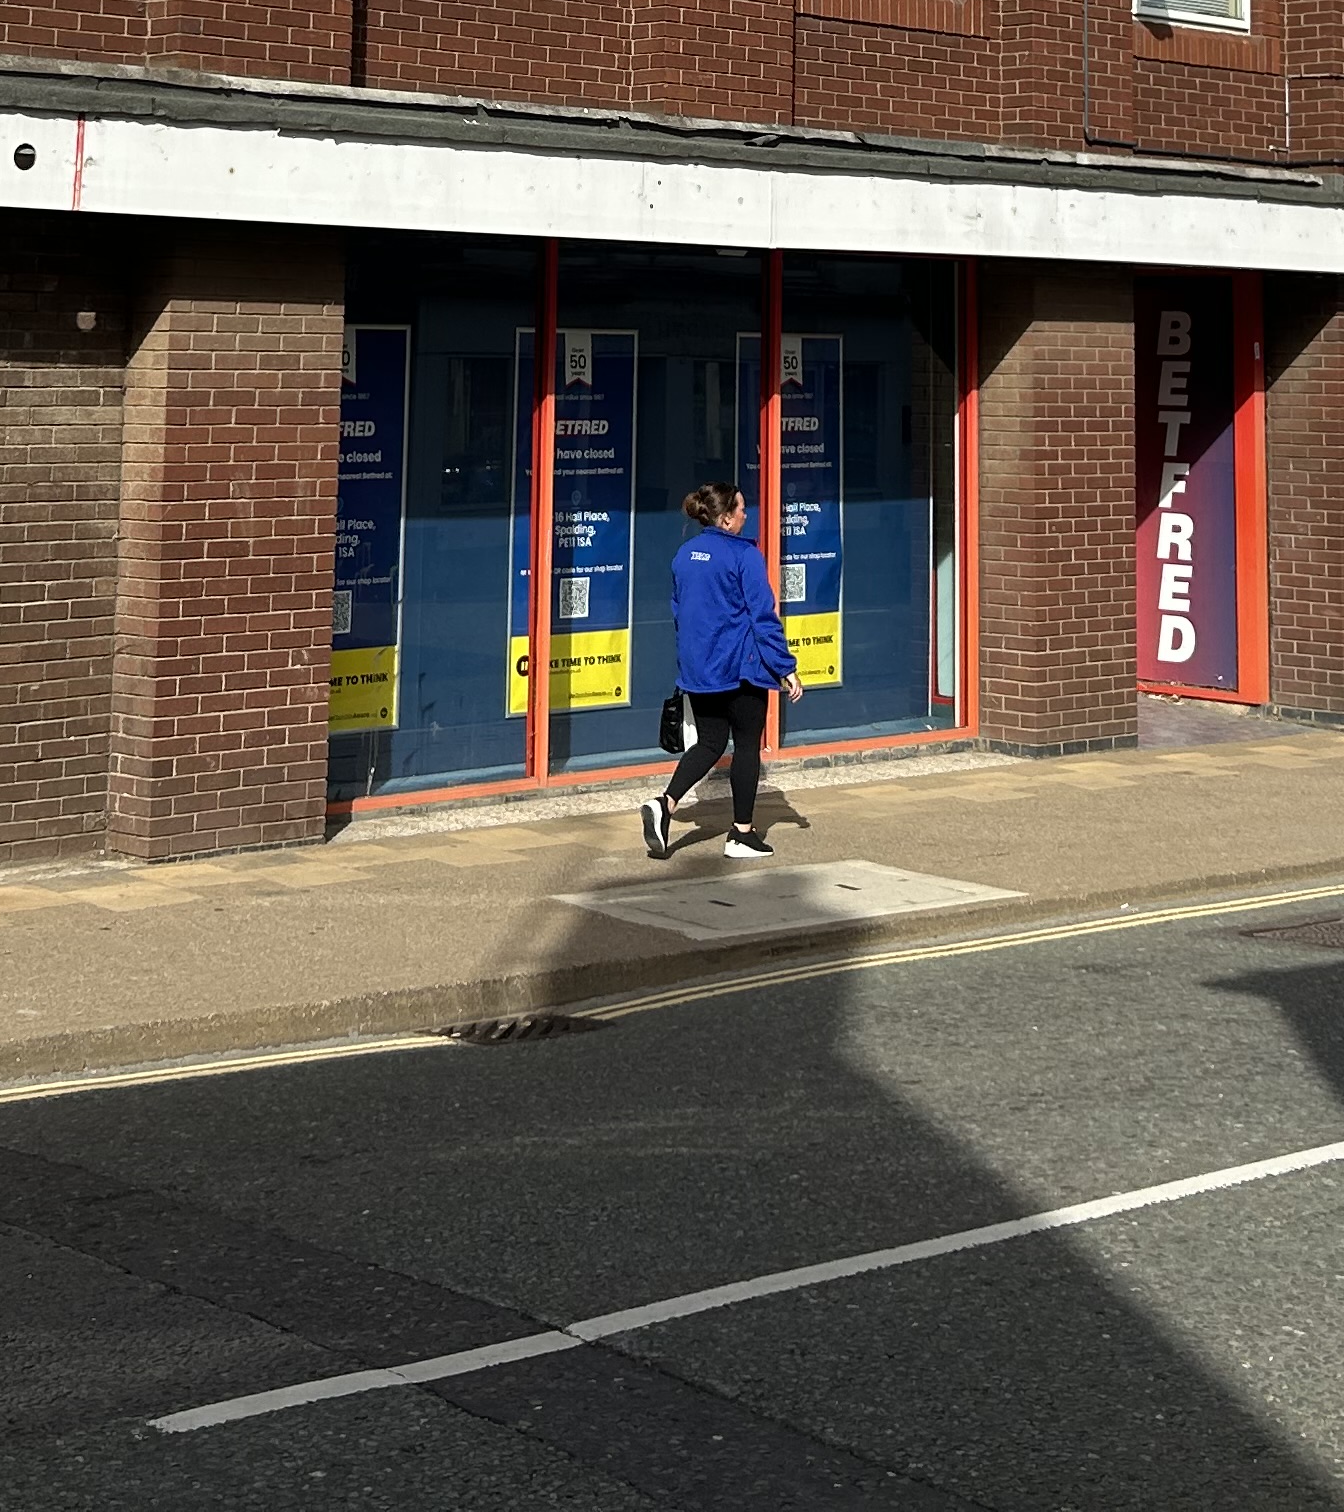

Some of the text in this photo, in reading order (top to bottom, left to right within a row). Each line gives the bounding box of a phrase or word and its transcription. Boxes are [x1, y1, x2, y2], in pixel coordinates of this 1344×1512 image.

[569, 354, 587, 369] 50
[783, 355, 798, 369] 50
[338, 420, 376, 437] FRED
[555, 419, 609, 435] ETFRED
[781, 416, 819, 432] TFRED
[556, 447, 615, 460] have closed
[797, 442, 825, 454] closed
[346, 450, 382, 463] closed
[1156, 310, 1197, 663] BETFRED
[565, 510, 583, 522] Hall
[583, 510, 611, 523] Place,
[347, 518, 377, 532] Place,
[554, 523, 597, 537] Spalding,
[336, 533, 361, 547] ding,
[558, 536, 576, 548] PE11
[801, 636, 812, 646] TO
[812, 634, 834, 646] THINK
[561, 657, 582, 668] TIME
[583, 655, 596, 666] TO
[597, 653, 622, 665] THINK
[345, 674, 359, 686] TO
[359, 672, 389, 685] THINK
